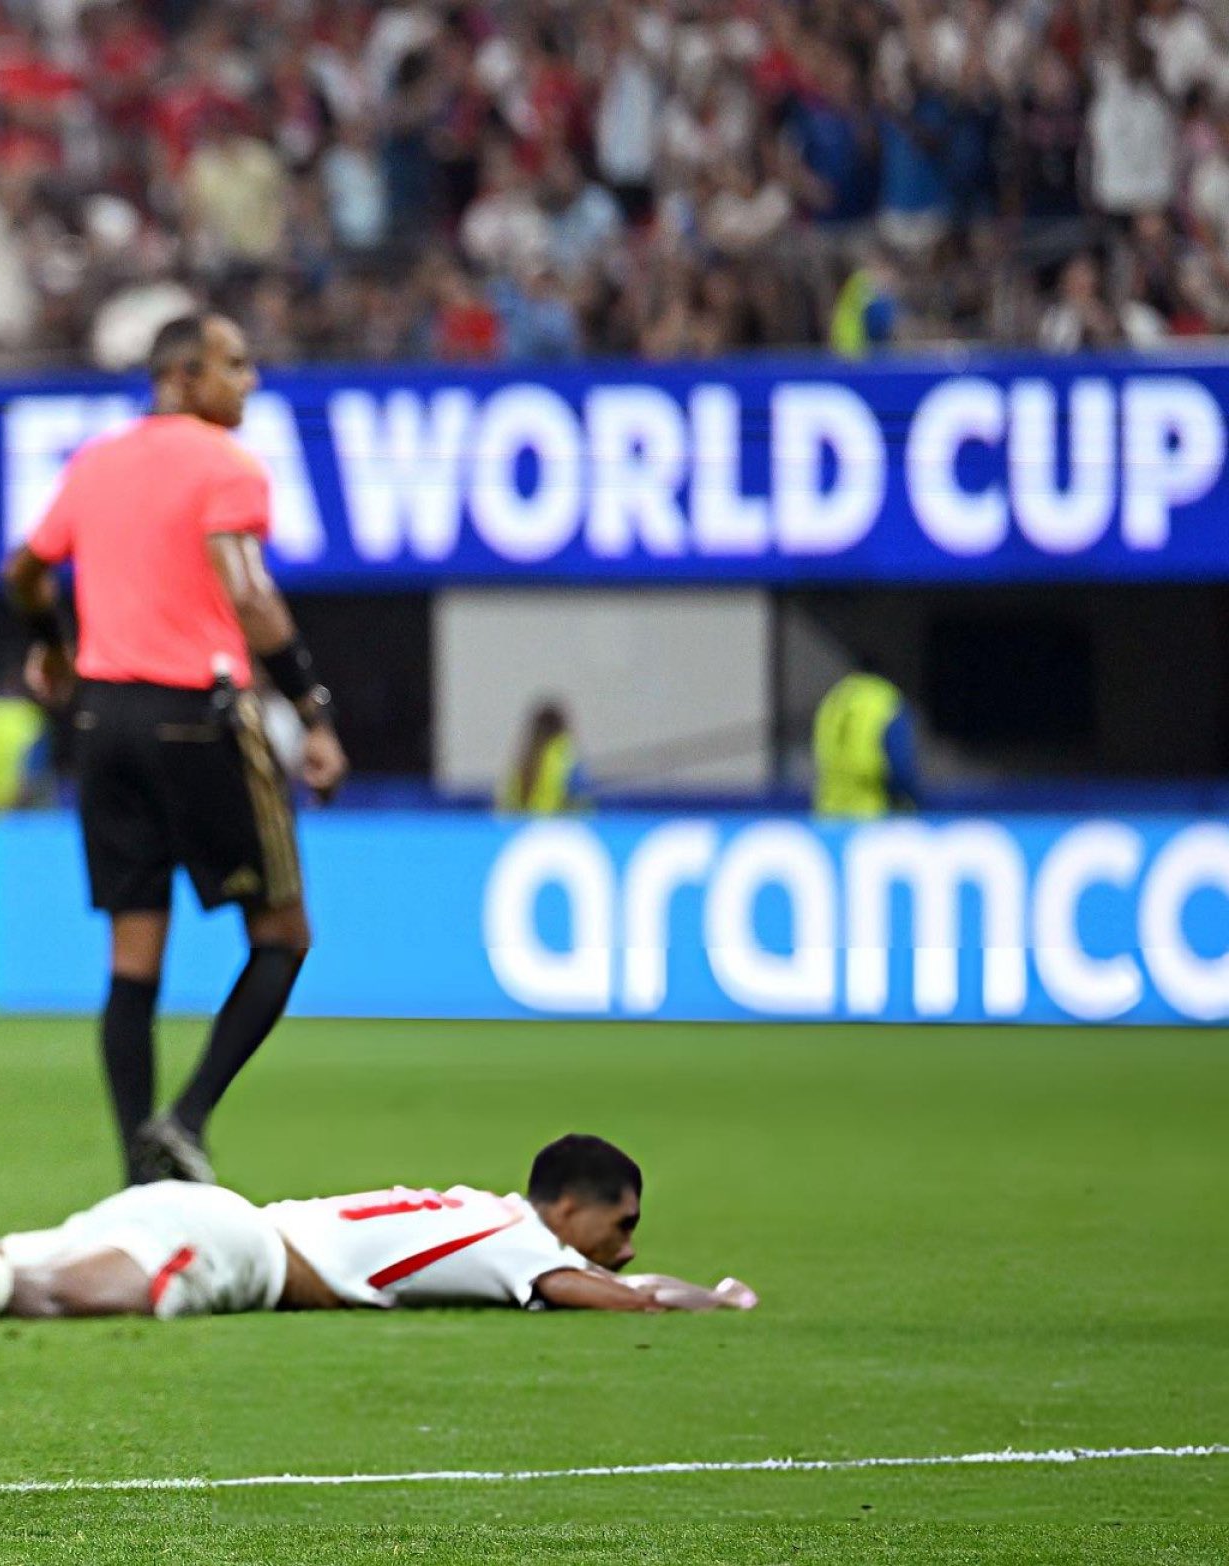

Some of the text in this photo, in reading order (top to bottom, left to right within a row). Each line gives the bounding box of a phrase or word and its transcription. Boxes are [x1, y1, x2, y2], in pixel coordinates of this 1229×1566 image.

[4, 375, 1226, 563] FA WORLD CUP
[481, 820, 1229, 1020] aramco
